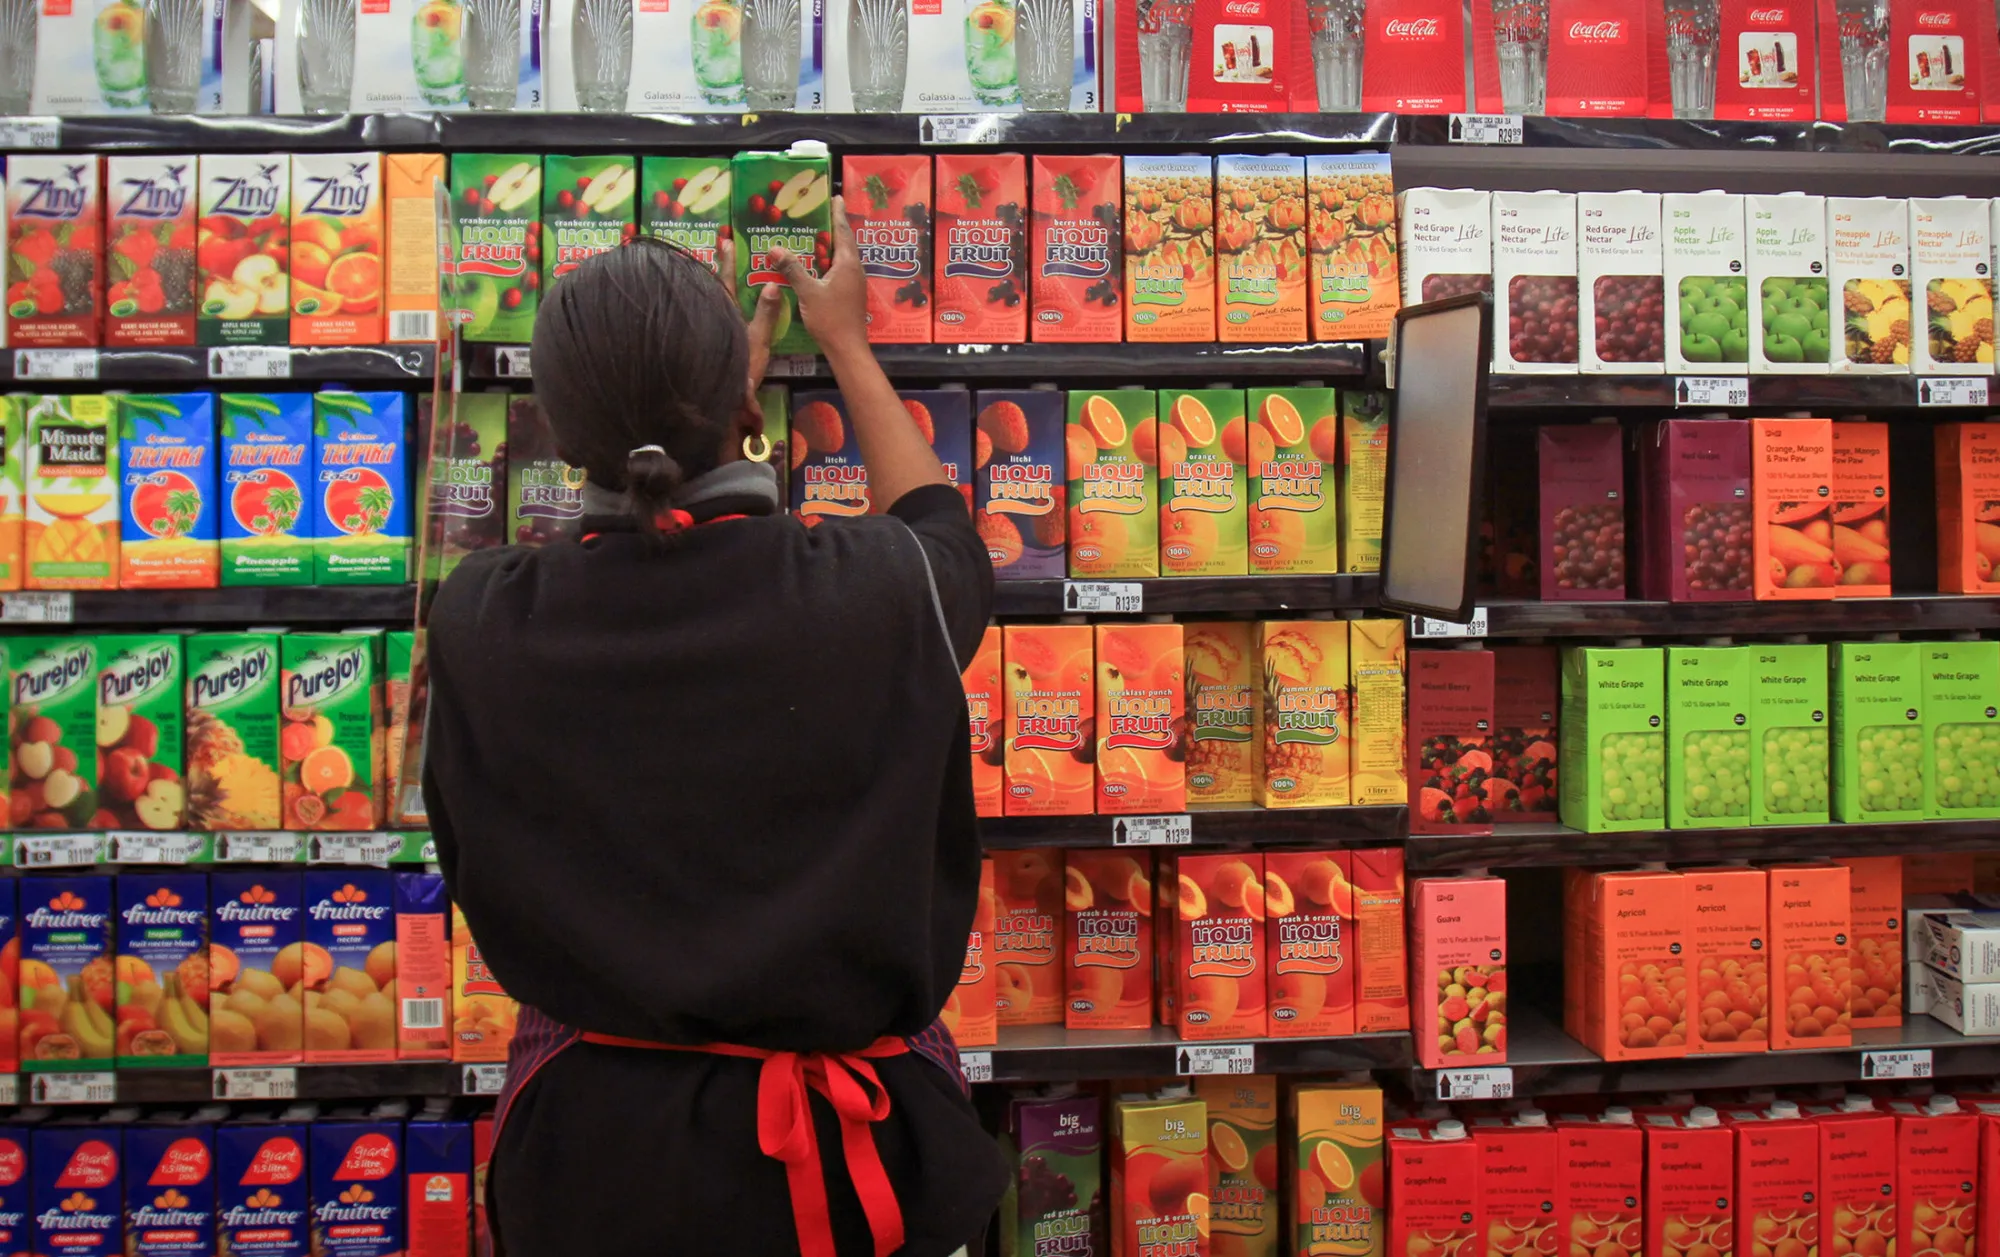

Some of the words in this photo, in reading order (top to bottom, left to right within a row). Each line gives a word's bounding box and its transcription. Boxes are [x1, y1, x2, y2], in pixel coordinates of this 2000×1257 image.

[1385, 18, 1438, 37] Coca-Cola
[1569, 20, 1620, 39] Coca-Cola
[531, 91, 539, 102] 3
[644, 91, 681, 100] Galassia
[813, 92, 821, 104] 3
[918, 92, 955, 101] Galassia
[1086, 92, 1093, 104] 3
[15, 176, 86, 219] Zing
[115, 176, 187, 219] Zing
[209, 176, 280, 218] Zing
[301, 176, 370, 218] Zing
[460, 218, 501, 226] cranberry
[554, 220, 595, 229] cranberry
[599, 220, 623, 228] cooler
[651, 221, 692, 229] cranberry
[747, 226, 788, 234] cranberry
[1414, 224, 1428, 232] Red
[1430, 224, 1454, 233] Grape
[1501, 225, 1516, 233] Red
[1518, 226, 1541, 235] Grape
[1586, 226, 1600, 234] Red
[1602, 226, 1626, 236] Grape
[1674, 227, 1696, 236] Apple
[1756, 228, 1777, 237] Apple
[1414, 234, 1440, 242] Nectar
[1502, 234, 1527, 243] Nectar
[1835, 230, 1870, 239] Pineapple
[1586, 235, 1612, 244] Nectar
[1674, 236, 1700, 244] Nectar
[1756, 237, 1781, 245] Nectar
[1835, 239, 1860, 248] Nectar
[1918, 240, 1942, 248] Nectar
[942, 313, 964, 321] 100%
[1040, 312, 1062, 320] 100%
[41, 428, 104, 446] Minute
[322, 443, 396, 465] TROPIKA
[1797, 445, 1824, 454] Mango
[129, 446, 204, 468] TROPIKA
[229, 444, 304, 466] TROPIKA
[1100, 454, 1127, 463] orange
[1190, 453, 1217, 462] orange
[1278, 453, 1305, 461] orange
[825, 456, 846, 464] litchi
[126, 473, 168, 485] Eazy
[226, 470, 268, 484] Eazy
[320, 470, 360, 482] Eazy
[236, 556, 298, 567] Pineapple
[328, 554, 390, 565] Pineapple
[1784, 676, 1806, 684] Grape
[1878, 675, 1900, 683] Grape
[1957, 673, 1979, 681] Grape
[1622, 681, 1644, 689] Grape
[1706, 679, 1728, 687] Grape
[1057, 690, 1080, 698] punch
[1697, 904, 1726, 913] Apricot
[1784, 900, 1811, 909] Apricot
[216, 900, 296, 921] fruitree
[310, 900, 384, 920] fruitree
[1617, 909, 1646, 918] Apricot
[26, 907, 105, 928] fruitree
[122, 904, 200, 926] fruitree
[1437, 915, 1460, 923] Guava
[1279, 916, 1301, 924] peach
[1340, 1104, 1360, 1119] big
[1060, 1114, 1079, 1128] big
[1165, 1119, 1185, 1133] big
[1058, 1209, 1079, 1218] grape
[37, 1209, 114, 1229] fruitree
[1136, 1216, 1161, 1226] mango
[1173, 1214, 1200, 1222] orange
